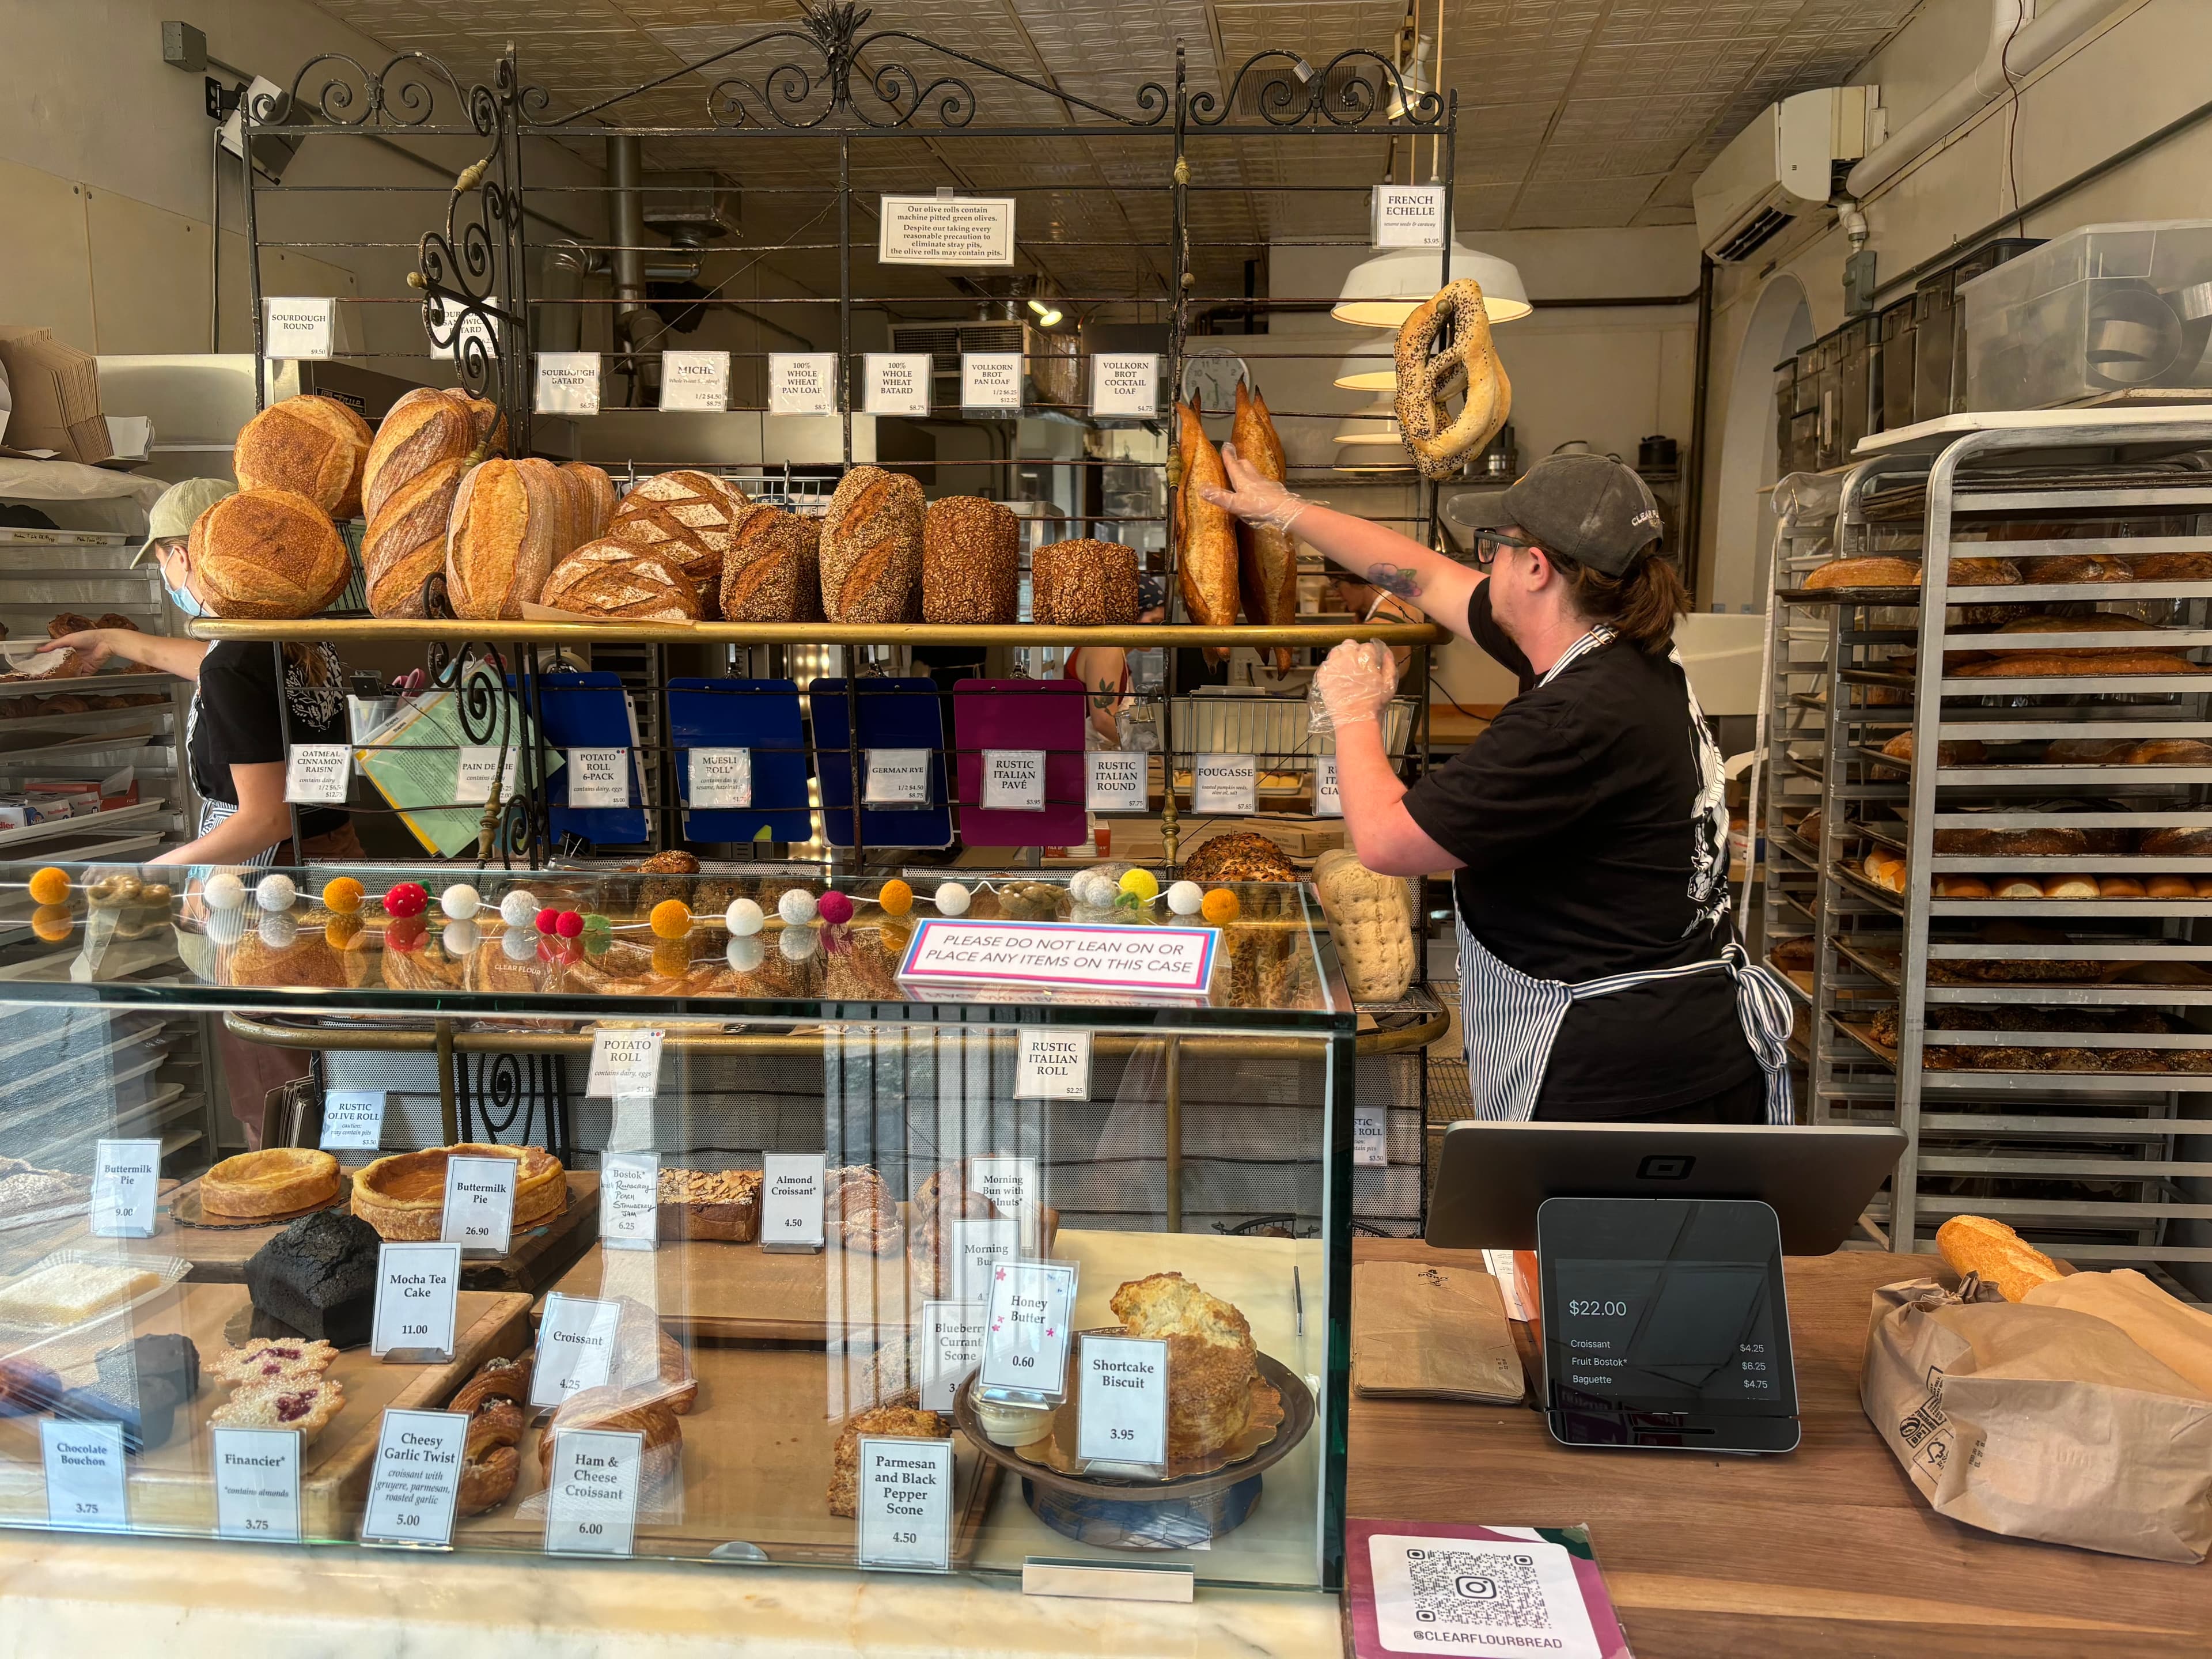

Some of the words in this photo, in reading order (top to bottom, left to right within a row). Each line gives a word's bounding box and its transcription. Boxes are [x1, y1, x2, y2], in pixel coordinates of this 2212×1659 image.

[1388, 196, 1433, 204] FRENCH
[996, 760, 1033, 768] RUSTIC
[994, 771, 1036, 779] ITALIAN
[1096, 772, 1137, 781] ITALIAN
[1198, 768, 1253, 777] FOUGASSE
[1002, 779, 1027, 789] PAVÉ
[943, 935, 1003, 948] PLEASE
[1006, 937, 1032, 948] DO
[1037, 939, 1075, 950] NOT
[1078, 941, 1122, 952] LEAN
[1126, 943, 1155, 953] ON
[1158, 944, 1184, 956] OR
[926, 949, 978, 962] PLACE
[980, 952, 1018, 964] ANY
[1021, 955, 1070, 967] ITEMS
[1073, 957, 1103, 968] ON
[1108, 959, 1142, 971] THIS
[1147, 961, 1193, 973] CASE
[604, 1041, 651, 1050] POTATO
[1032, 1043, 1076, 1051] RUSTIC
[610, 1053, 641, 1061] ROLL
[1029, 1054, 1078, 1063] ITALIAN
[1037, 1067, 1068, 1075] ROLL
[105, 1165, 152, 1173] Buttermilk
[120, 1176, 134, 1184] Pie
[984, 1175, 1023, 1185] Morning
[457, 1183, 506, 1192] Buttermilk
[473, 1195, 487, 1203] Pie
[465, 1227, 488, 1236] 26.90
[965, 1244, 1008, 1255] Morning
[390, 1275, 426, 1284] Mocha
[429, 1275, 446, 1283] Tea
[404, 1288, 431, 1297] Cake
[1011, 1296, 1047, 1311] Honey
[1569, 1300, 1627, 1317] $22.00
[1011, 1311, 1046, 1324] Butter
[402, 1325, 428, 1334] 11.00
[554, 1331, 603, 1346] Croissant
[1571, 1339, 1611, 1349] Croissant
[1740, 1344, 1764, 1353] $4.25
[945, 1351, 976, 1361] Scone
[1013, 1355, 1035, 1368] 0.60
[1093, 1359, 1154, 1373] Shortcake
[1571, 1357, 1592, 1366] Fruit
[1741, 1362, 1766, 1371] $6.25
[560, 1378, 580, 1389] 4.25
[1103, 1376, 1145, 1388] Biscuit
[1573, 1375, 1612, 1385] Baguette
[1744, 1380, 1768, 1389] $4.75
[1111, 1429, 1134, 1440] 3.95
[402, 1433, 443, 1449] Cheesy
[57, 1442, 107, 1454] Chocolate
[61, 1455, 105, 1466] Bouchon
[385, 1448, 419, 1461] Garlic
[423, 1450, 455, 1464] Twist
[575, 1454, 604, 1467] Ham
[608, 1457, 619, 1467] &
[876, 1456, 935, 1469] Parmesan
[388, 1469, 423, 1479] croissant
[425, 1471, 443, 1480] with
[574, 1469, 617, 1483] Cheese
[875, 1472, 898, 1483] and
[902, 1473, 937, 1484] Black
[259, 1488, 289, 1497] almonds
[376, 1481, 408, 1491] gruyere,
[411, 1484, 450, 1494] parmesan,
[566, 1484, 623, 1499] Croissant
[385, 1494, 413, 1502] roasted
[415, 1495, 438, 1505] garlic
[884, 1487, 928, 1502] Pepper
[75, 1503, 99, 1513] 3.75
[887, 1503, 923, 1516] Scone
[246, 1520, 268, 1530] 3.75
[396, 1514, 420, 1526] 5.00
[579, 1523, 603, 1535] 6.00
[893, 1532, 916, 1543] 4.50
[1414, 1631, 1563, 1649] @CLEARFLOURBREAD
